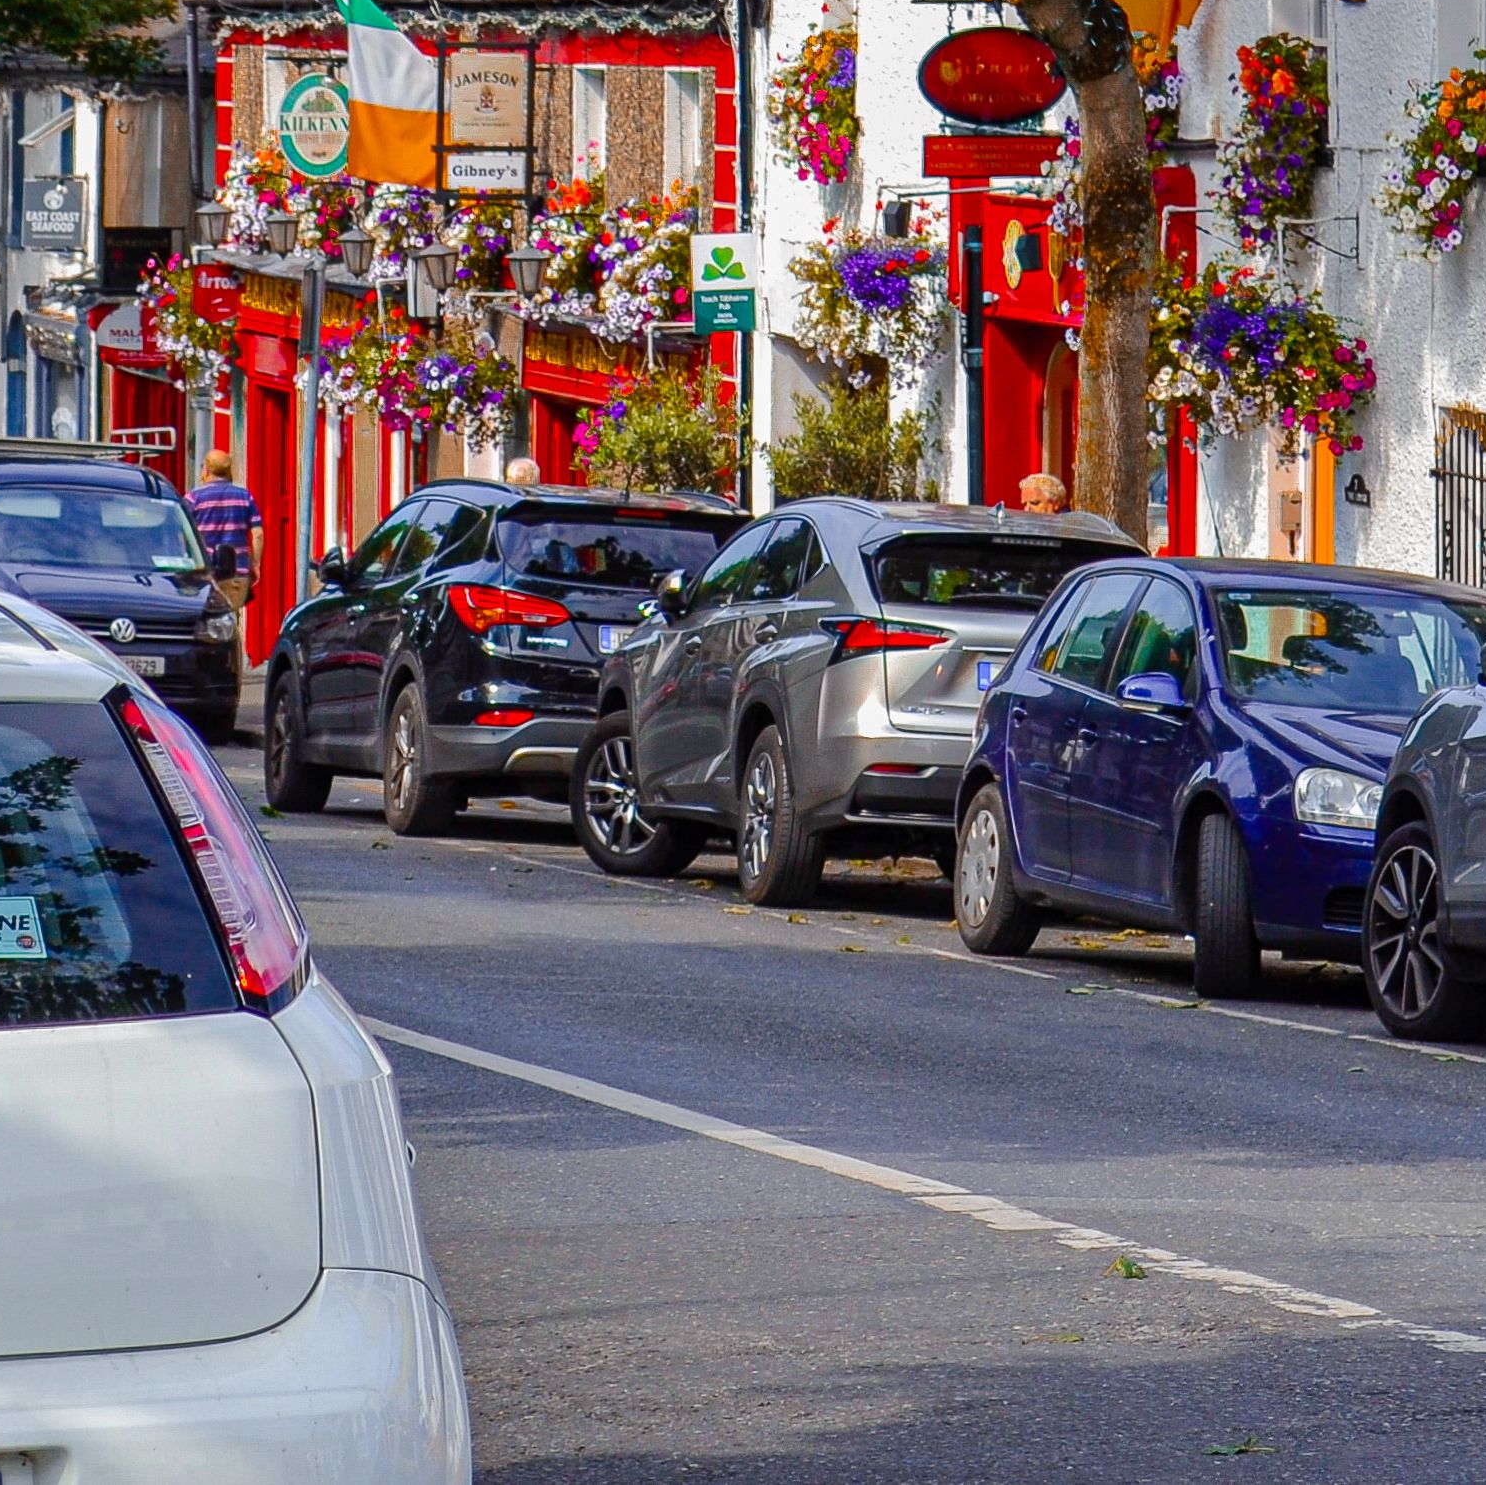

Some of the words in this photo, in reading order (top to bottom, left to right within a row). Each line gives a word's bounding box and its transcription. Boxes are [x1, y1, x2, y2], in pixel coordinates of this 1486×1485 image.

[454, 70, 519, 89] JAMESON
[452, 164, 518, 181] Gibney's
[25, 211, 48, 222] EAST
[50, 211, 80, 223] COAST
[31, 222, 75, 232] SEAFOOD
